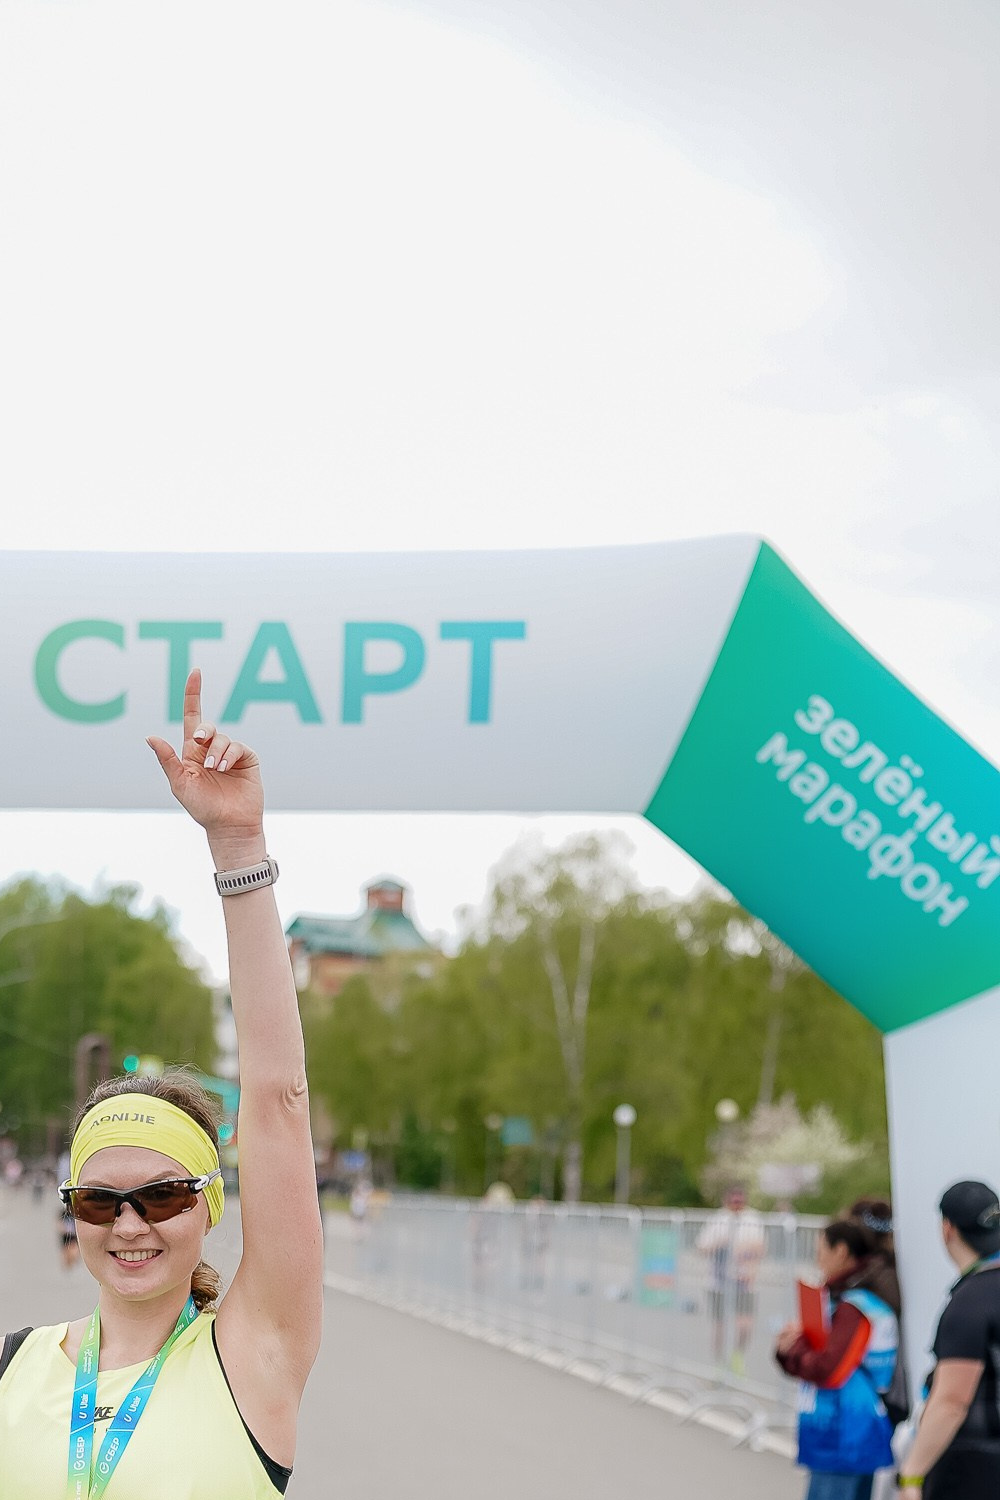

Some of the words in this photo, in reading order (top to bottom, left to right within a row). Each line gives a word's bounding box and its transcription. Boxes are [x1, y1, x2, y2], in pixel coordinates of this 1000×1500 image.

[32, 618, 527, 724] СТАРТ
[755, 731, 969, 927] марафон
[76, 1436, 86, 1459] СБЕР
[105, 1437, 120, 1463] СБЕР
